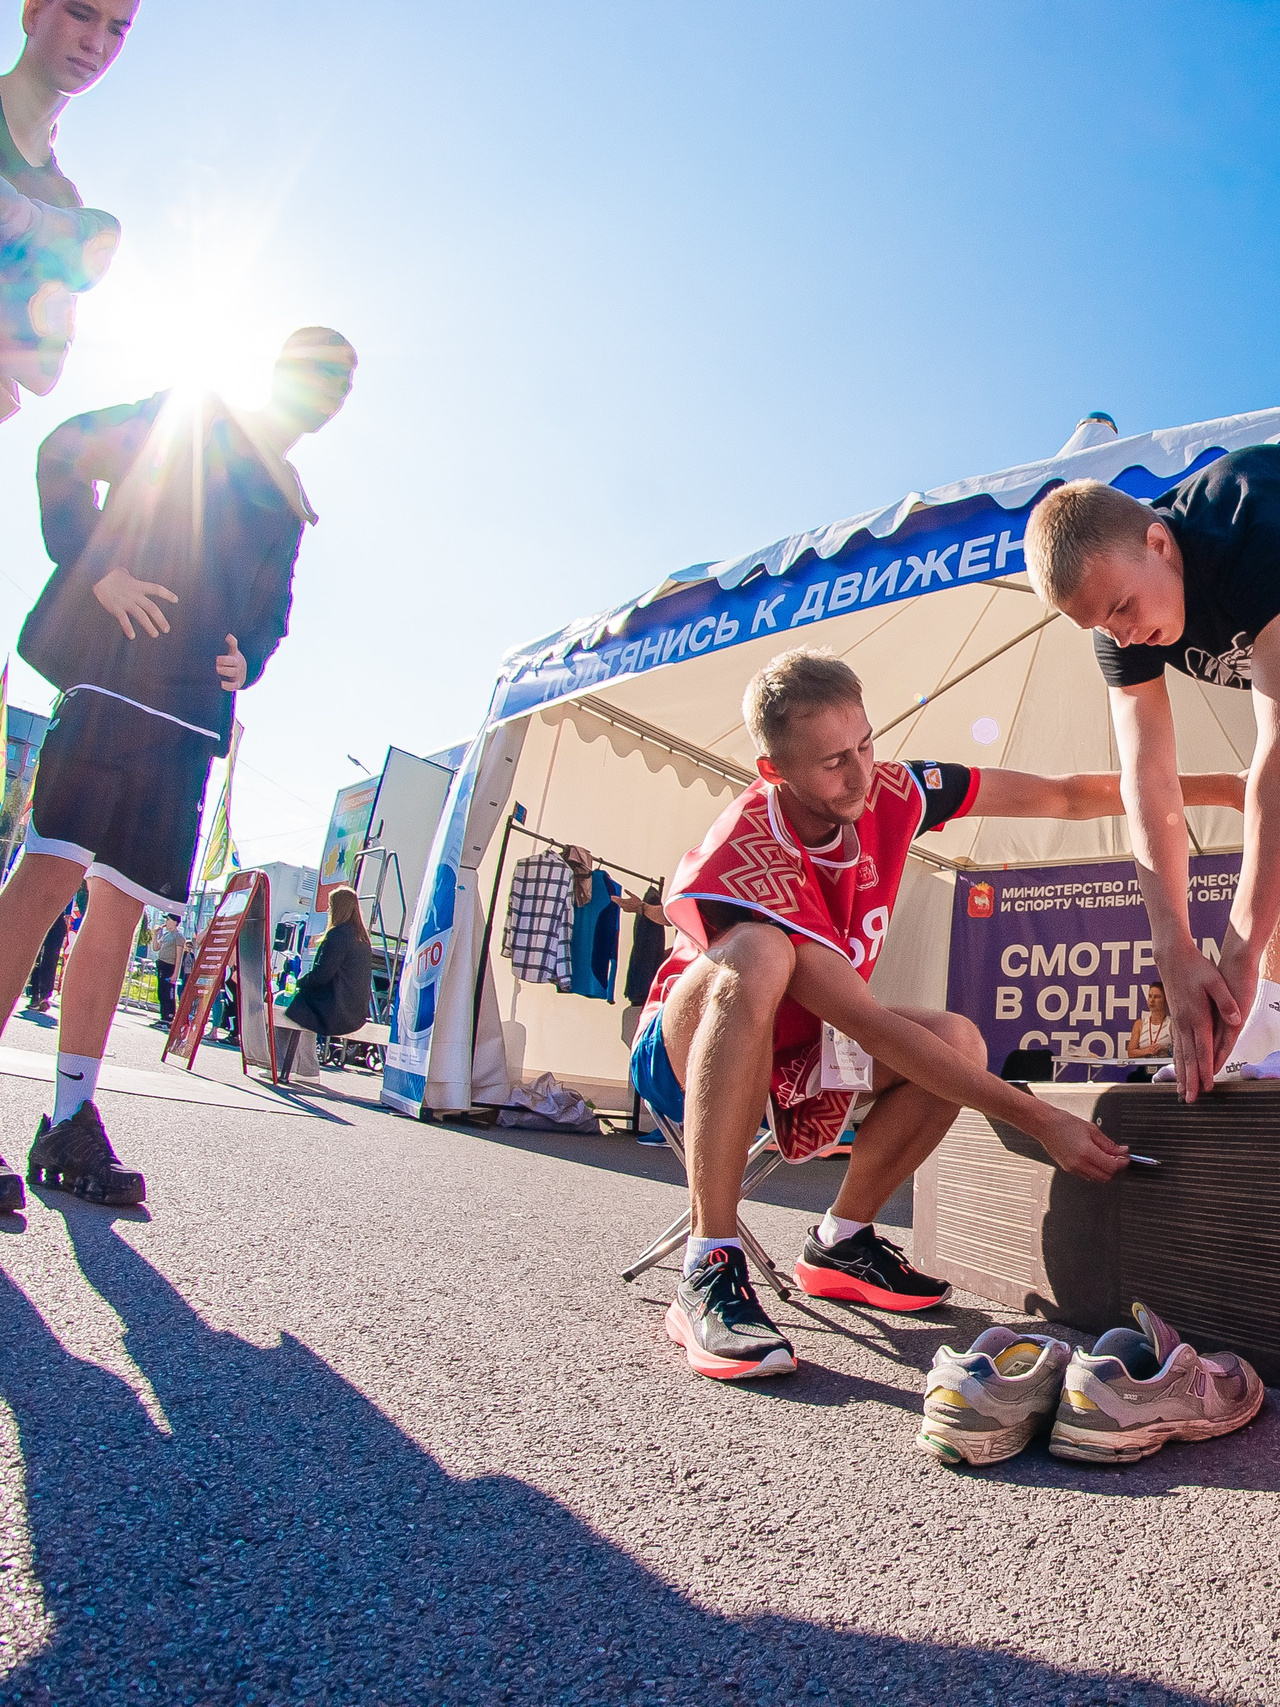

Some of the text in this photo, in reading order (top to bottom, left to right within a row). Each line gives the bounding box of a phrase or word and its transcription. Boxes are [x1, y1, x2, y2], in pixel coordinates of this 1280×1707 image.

[543, 530, 1024, 703] ПОДТЯНИСЬ К ДВИЖЕН
[1001, 888, 1235, 913] И СПОРТУ ЧЕЛЯБИН ОБЛ
[1002, 881, 1123, 899] МИНИСТЕРСТВО
[416, 941, 444, 977] ГТО
[995, 986, 1024, 1020] В
